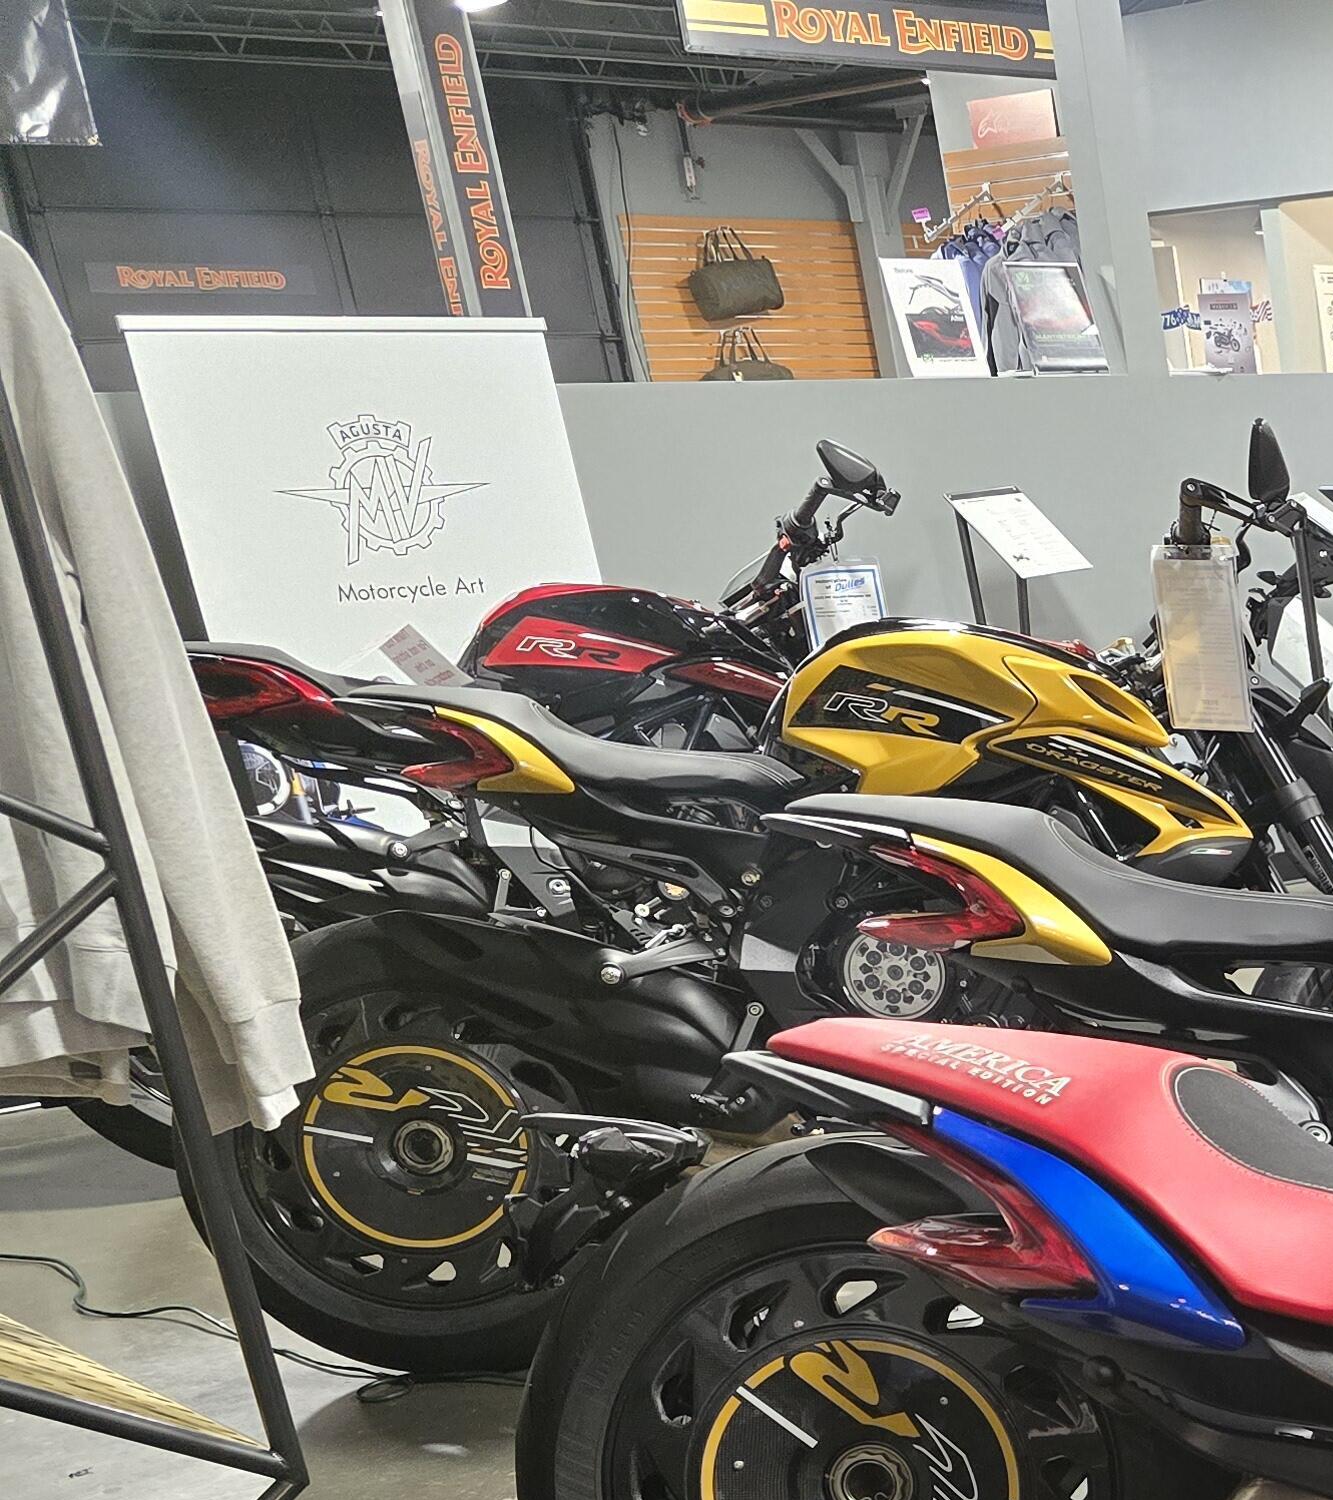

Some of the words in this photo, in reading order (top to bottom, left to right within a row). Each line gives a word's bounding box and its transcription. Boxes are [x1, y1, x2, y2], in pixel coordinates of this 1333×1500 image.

[775, 0, 891, 47] ROYAL
[899, 9, 1029, 61] ENFIELD
[434, 33, 490, 175] ENFIELD
[414, 139, 448, 251] ROYAL
[466, 180, 511, 290] ROYAL
[117, 266, 196, 289] ROYAL
[197, 267, 286, 290] ENFIELD
[339, 423, 402, 443] AGUSTA
[348, 436, 432, 566] MV
[338, 575, 447, 604] Motorcycle
[455, 577, 485, 595] Art
[516, 636, 619, 665] RR
[822, 692, 941, 737] RR
[1025, 741, 1163, 793] DRAGSTER
[881, 1042, 959, 1071] SPECIAL
[967, 1065, 1054, 1105] EDITION
[890, 1034, 1071, 1097] AMERICA
